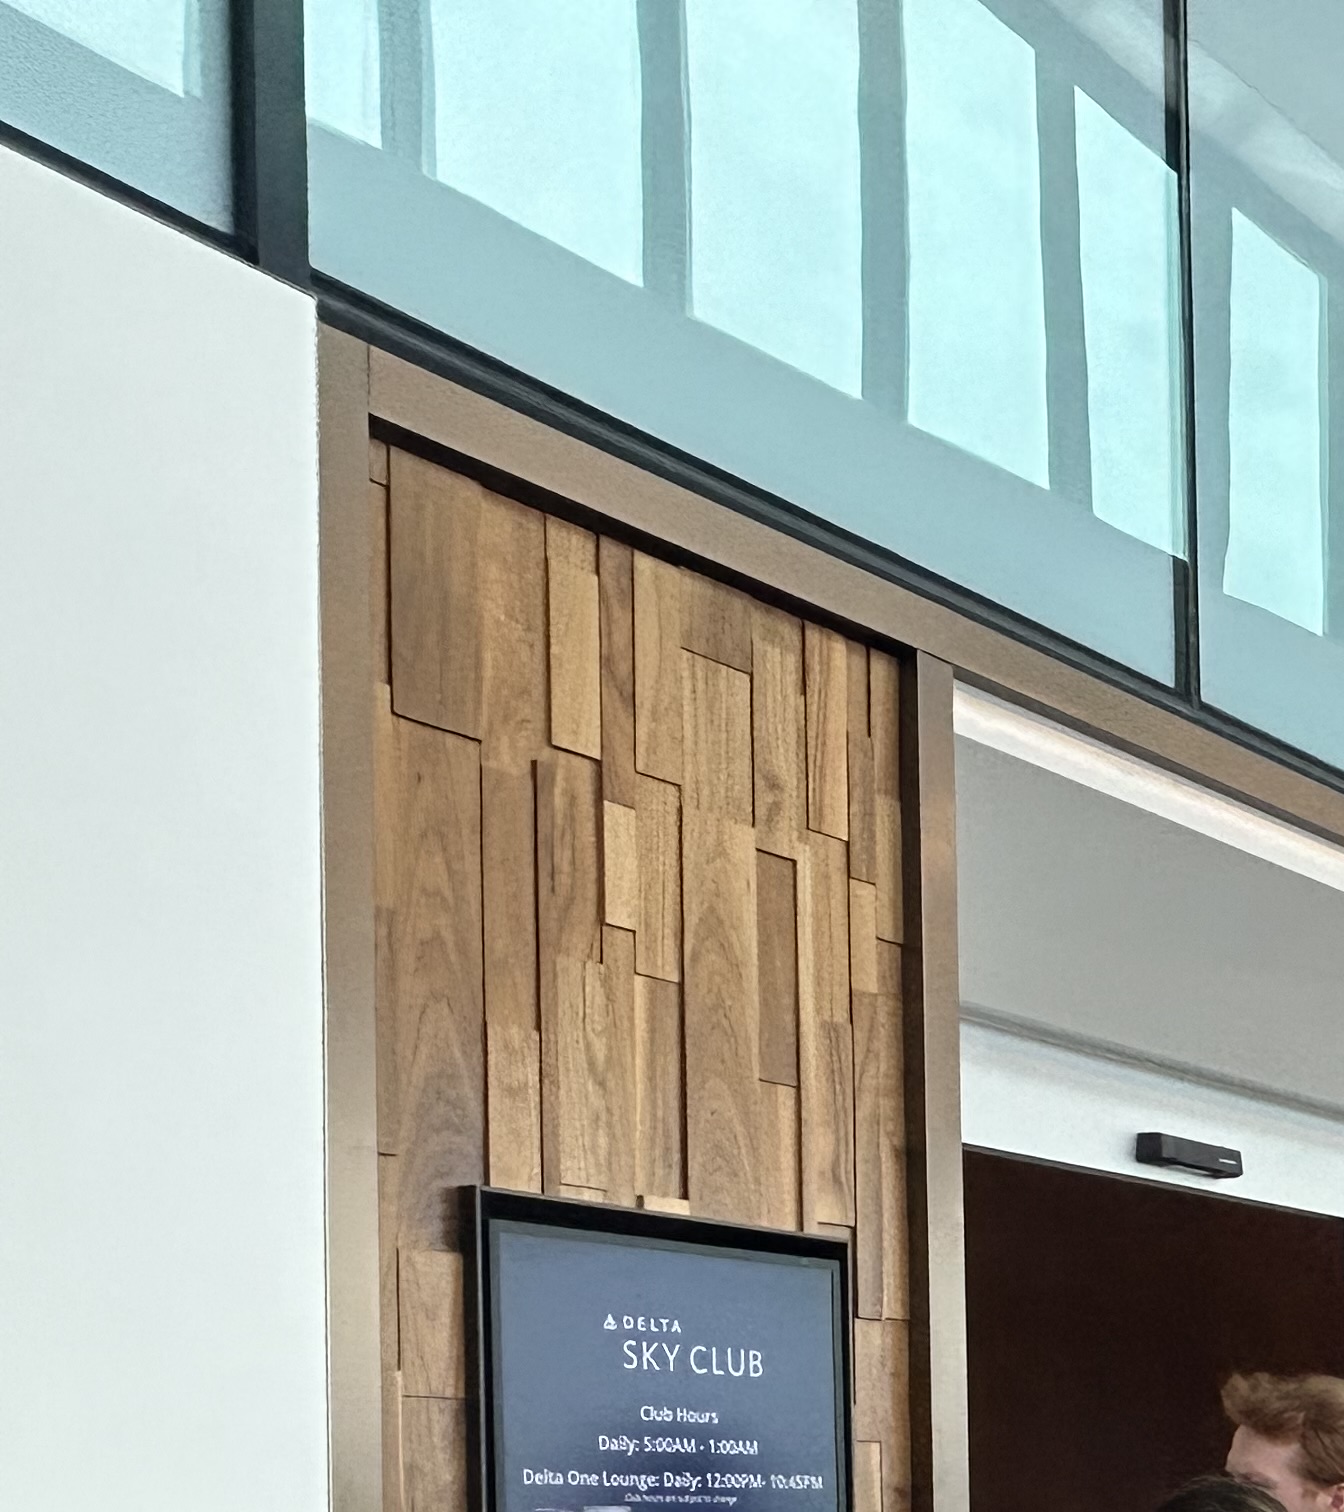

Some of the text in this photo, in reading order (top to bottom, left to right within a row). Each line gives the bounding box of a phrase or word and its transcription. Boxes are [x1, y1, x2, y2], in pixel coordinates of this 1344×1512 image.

[622, 1315, 683, 1334] DELTA
[622, 1340, 765, 1378] SKY CLUB
[640, 1405, 720, 1425] Club Hours
[598, 1435, 640, 1457] Daily:
[643, 1437, 697, 1455] 5:00AM
[708, 1438, 760, 1456] 1:00AM
[522, 1468, 565, 1487] Delta
[568, 1470, 600, 1487] One
[602, 1471, 660, 1491] Lounge:
[663, 1472, 703, 1492] Daily:
